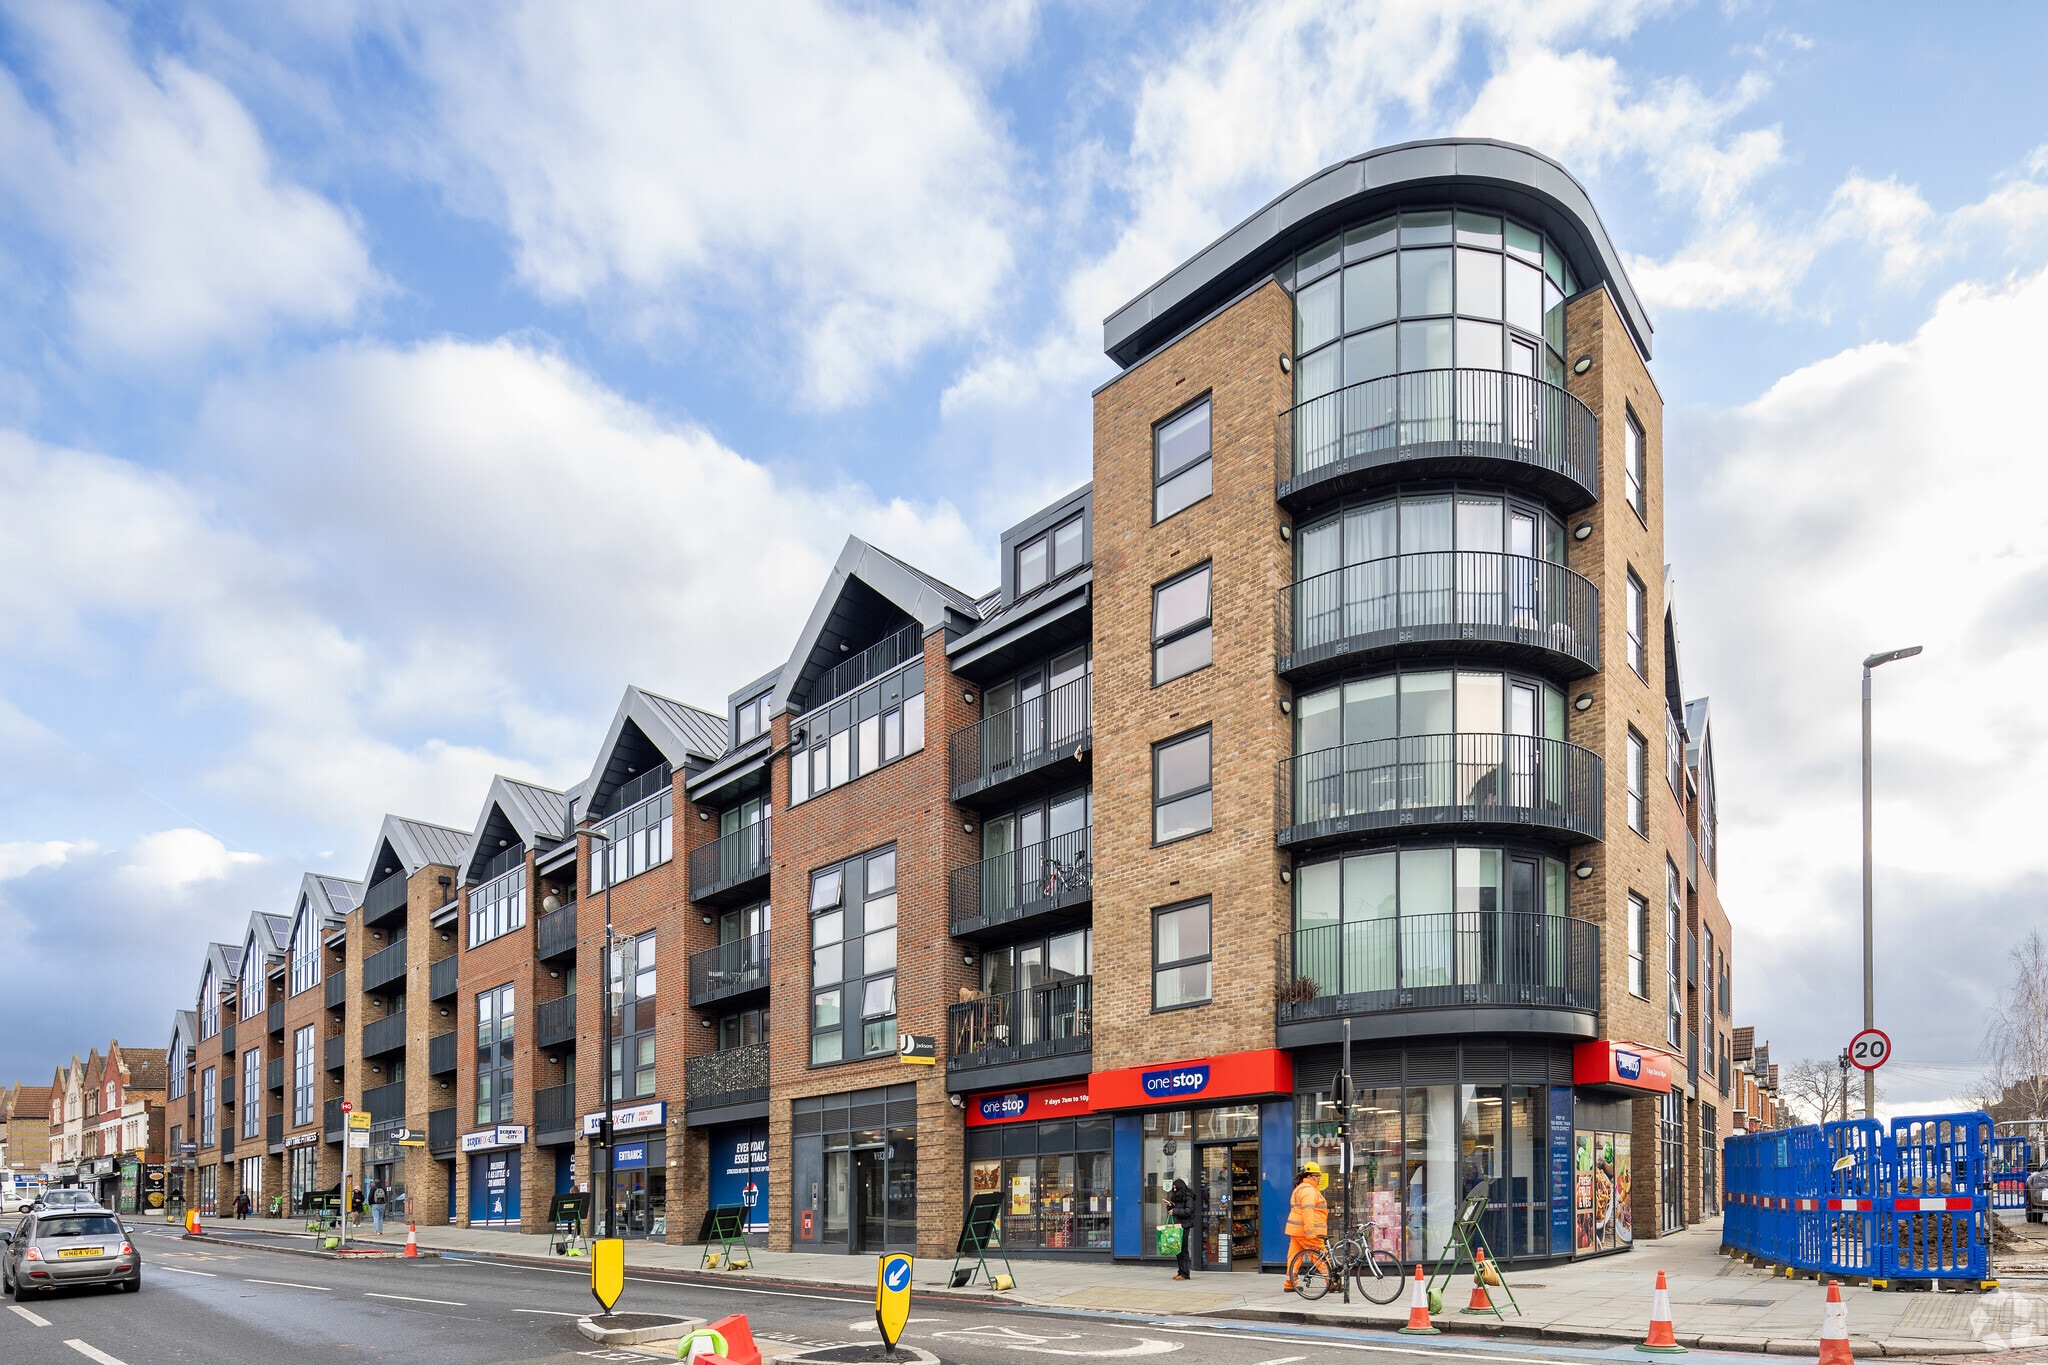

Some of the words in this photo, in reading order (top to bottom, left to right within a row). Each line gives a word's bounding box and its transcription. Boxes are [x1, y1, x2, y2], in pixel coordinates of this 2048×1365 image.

[1855, 1041, 1884, 1058] 20
[1147, 1077, 1170, 1090] one
[1173, 1072, 1203, 1090] stop
[983, 1102, 1000, 1113] one
[1001, 1098, 1024, 1112] stop
[621, 1113, 635, 1124] CITY
[619, 1149, 643, 1161] ENTRANCE
